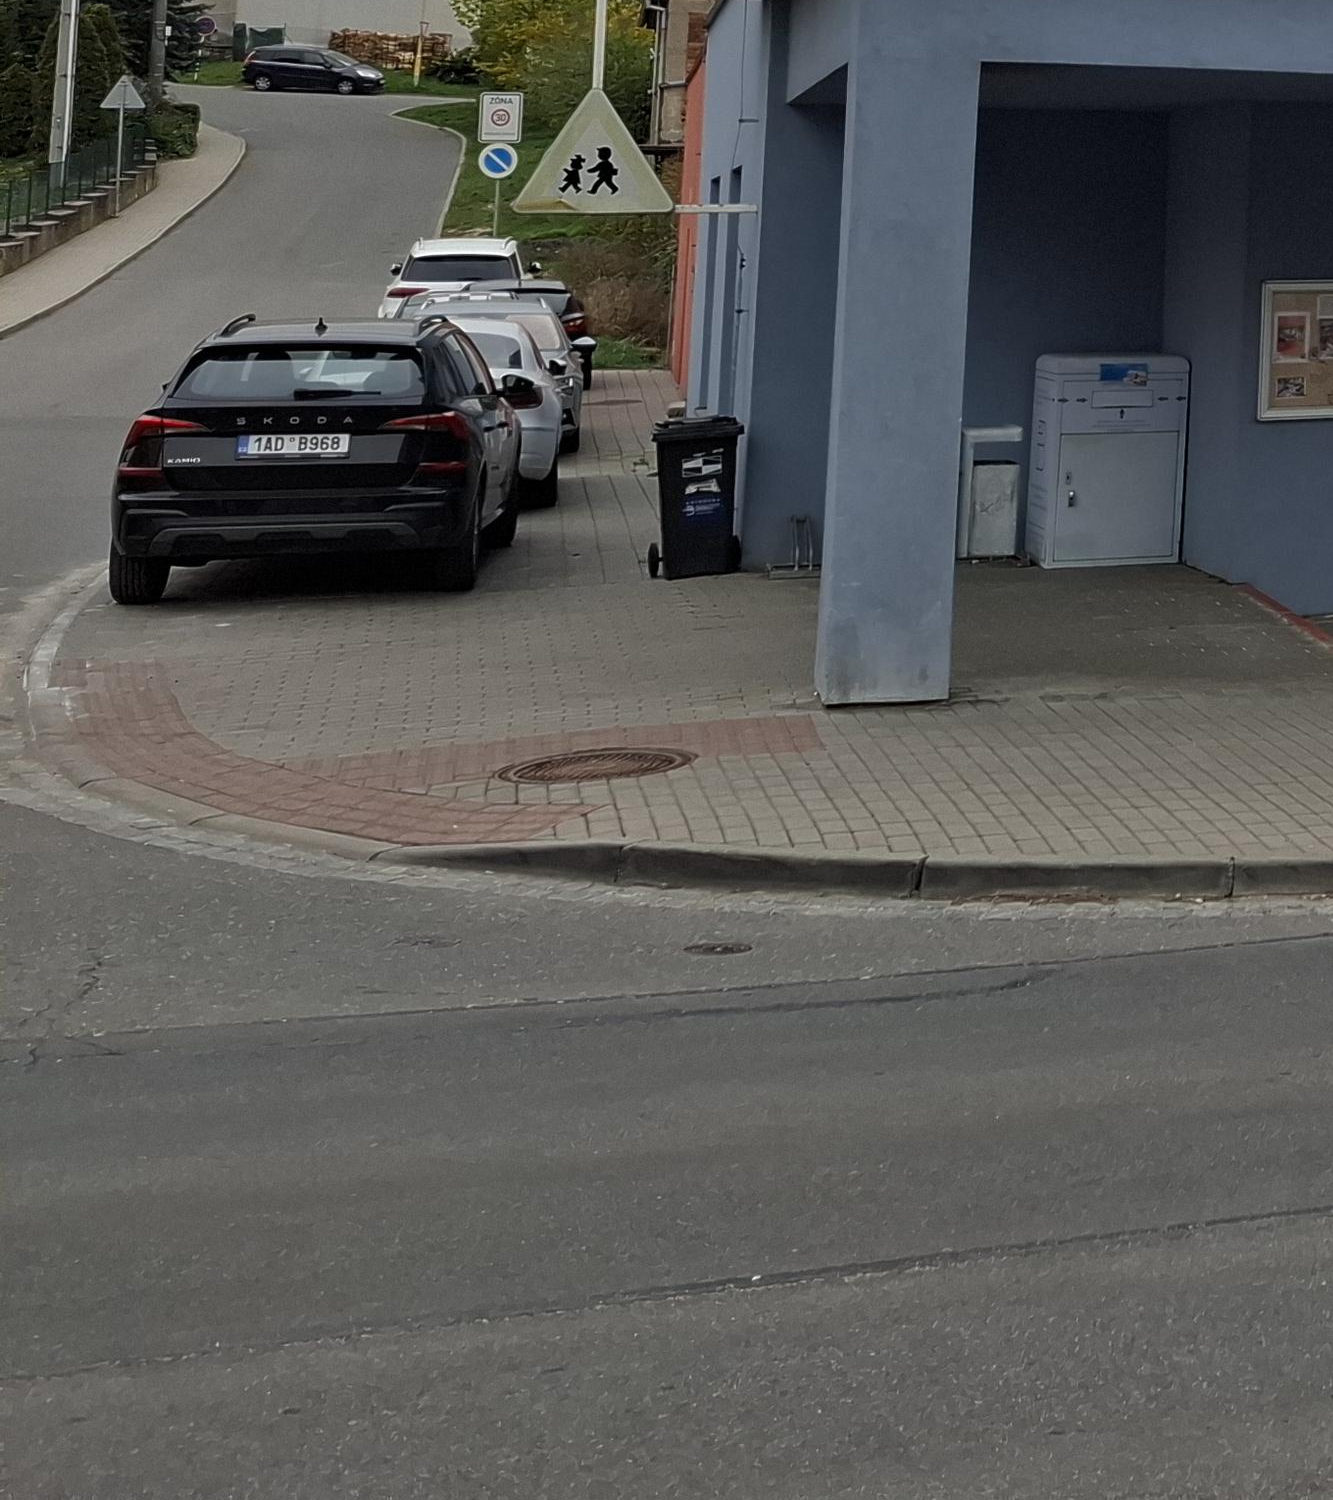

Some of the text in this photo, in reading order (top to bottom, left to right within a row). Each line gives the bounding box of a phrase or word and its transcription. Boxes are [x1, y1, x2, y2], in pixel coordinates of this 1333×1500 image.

[495, 113, 507, 122] 30
[254, 436, 341, 452] 1AD B968
